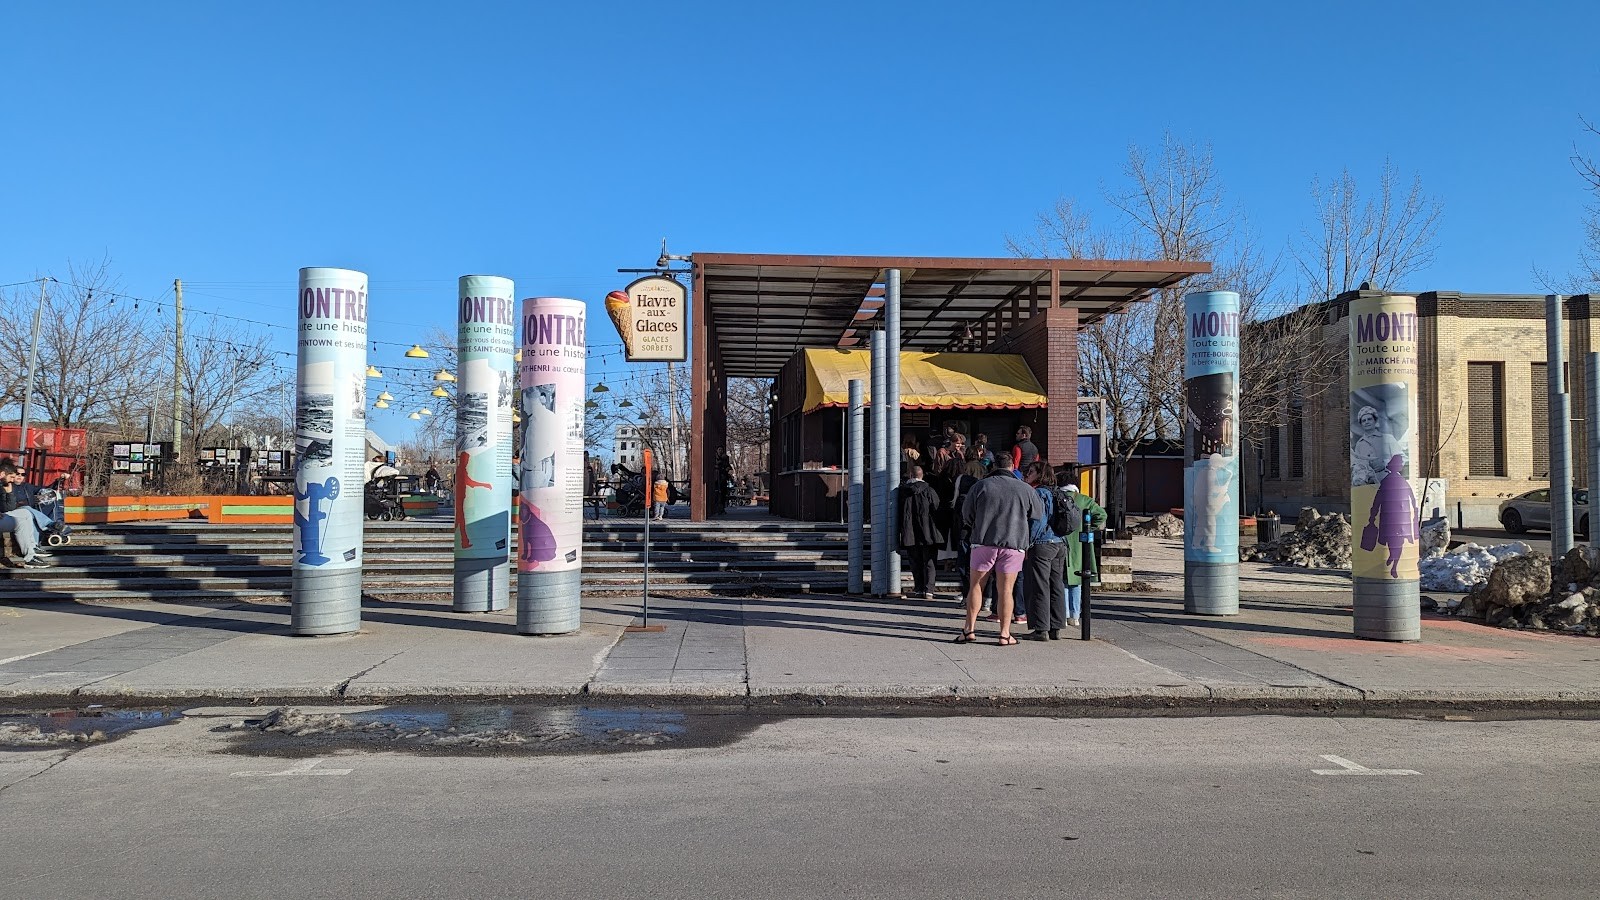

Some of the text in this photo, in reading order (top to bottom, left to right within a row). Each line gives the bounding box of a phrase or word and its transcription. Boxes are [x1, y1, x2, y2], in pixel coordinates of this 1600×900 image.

[637, 294, 676, 307] Havre
[460, 294, 514, 327] ONTRÉ
[299, 323, 312, 331] ute
[316, 323, 338, 331] une
[461, 326, 471, 334] ute
[495, 325, 514, 336] histo
[636, 319, 678, 332] Glaces
[1191, 339, 1218, 347] Toute
[522, 347, 585, 359] ute une histo
[1356, 344, 1388, 354] Toute
[1392, 345, 1411, 353] une
[1365, 355, 1400, 365] MARCHÉ
[1366, 367, 1392, 375] édifice
